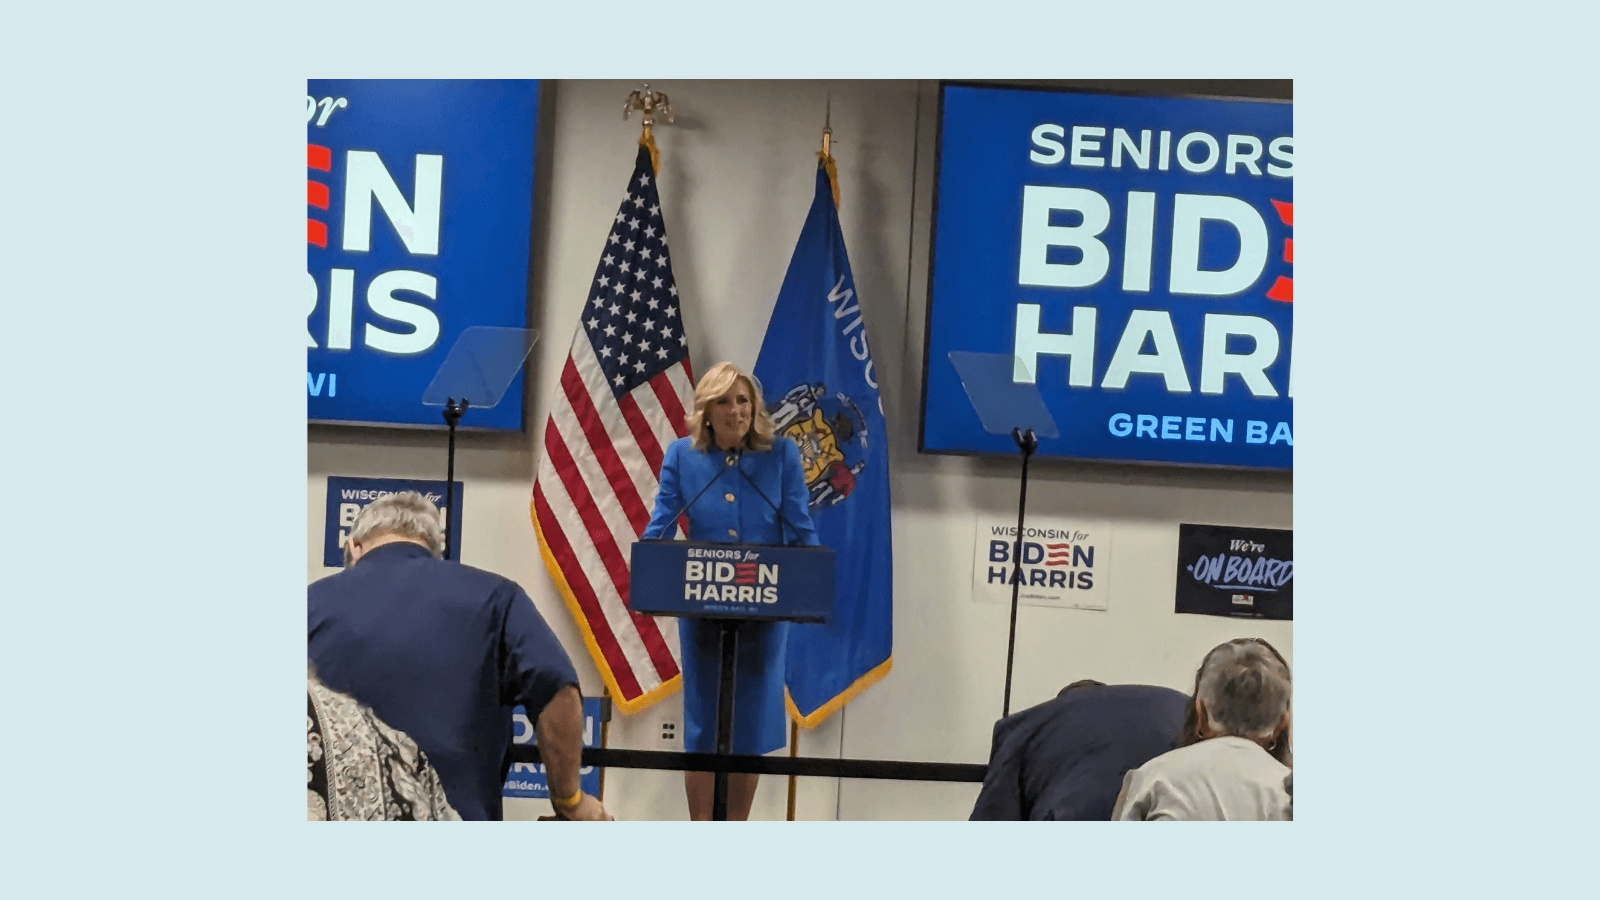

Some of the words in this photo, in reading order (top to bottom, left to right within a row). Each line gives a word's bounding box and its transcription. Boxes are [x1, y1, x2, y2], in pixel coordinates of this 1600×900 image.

[1029, 123, 1293, 177] SENIORS
[1018, 184, 1293, 303] BID
[1012, 303, 1293, 397] HAR
[1108, 412, 1234, 443] GREEN
[1070, 530, 1089, 542] for
[1229, 539, 1265, 553] We're
[687, 548, 742, 560] SENIORS
[741, 550, 760, 562] for
[685, 560, 779, 585] BIDEN
[987, 566, 1094, 590] HARRIS
[684, 583, 778, 604] HARRIS
